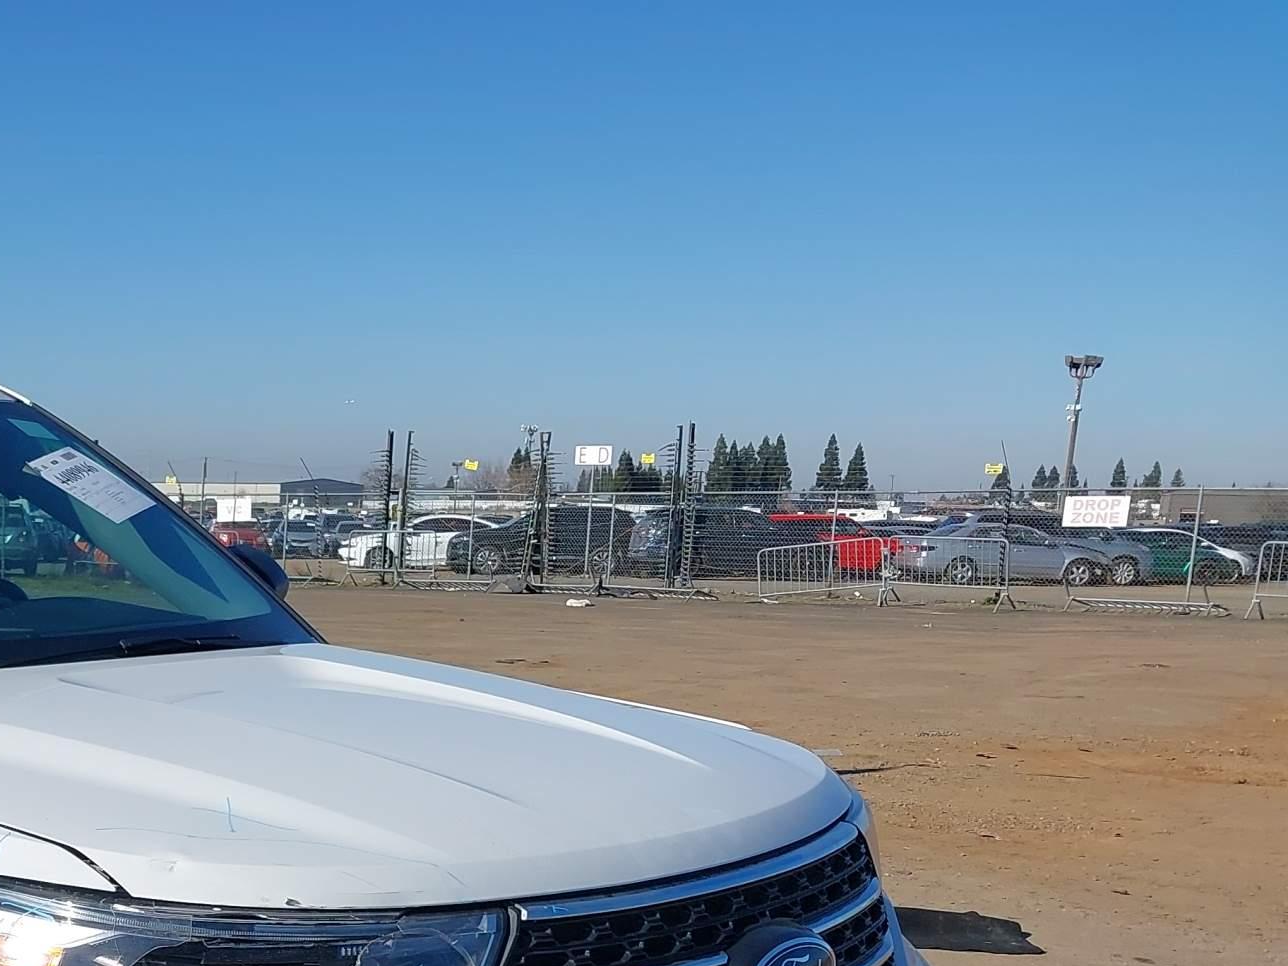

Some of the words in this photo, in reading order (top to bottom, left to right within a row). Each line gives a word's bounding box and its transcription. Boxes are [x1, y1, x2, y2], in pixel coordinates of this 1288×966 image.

[578, 447, 587, 464] E
[598, 447, 610, 464] D
[1072, 498, 1122, 512] DROP
[1070, 512, 1121, 524] ZONE
